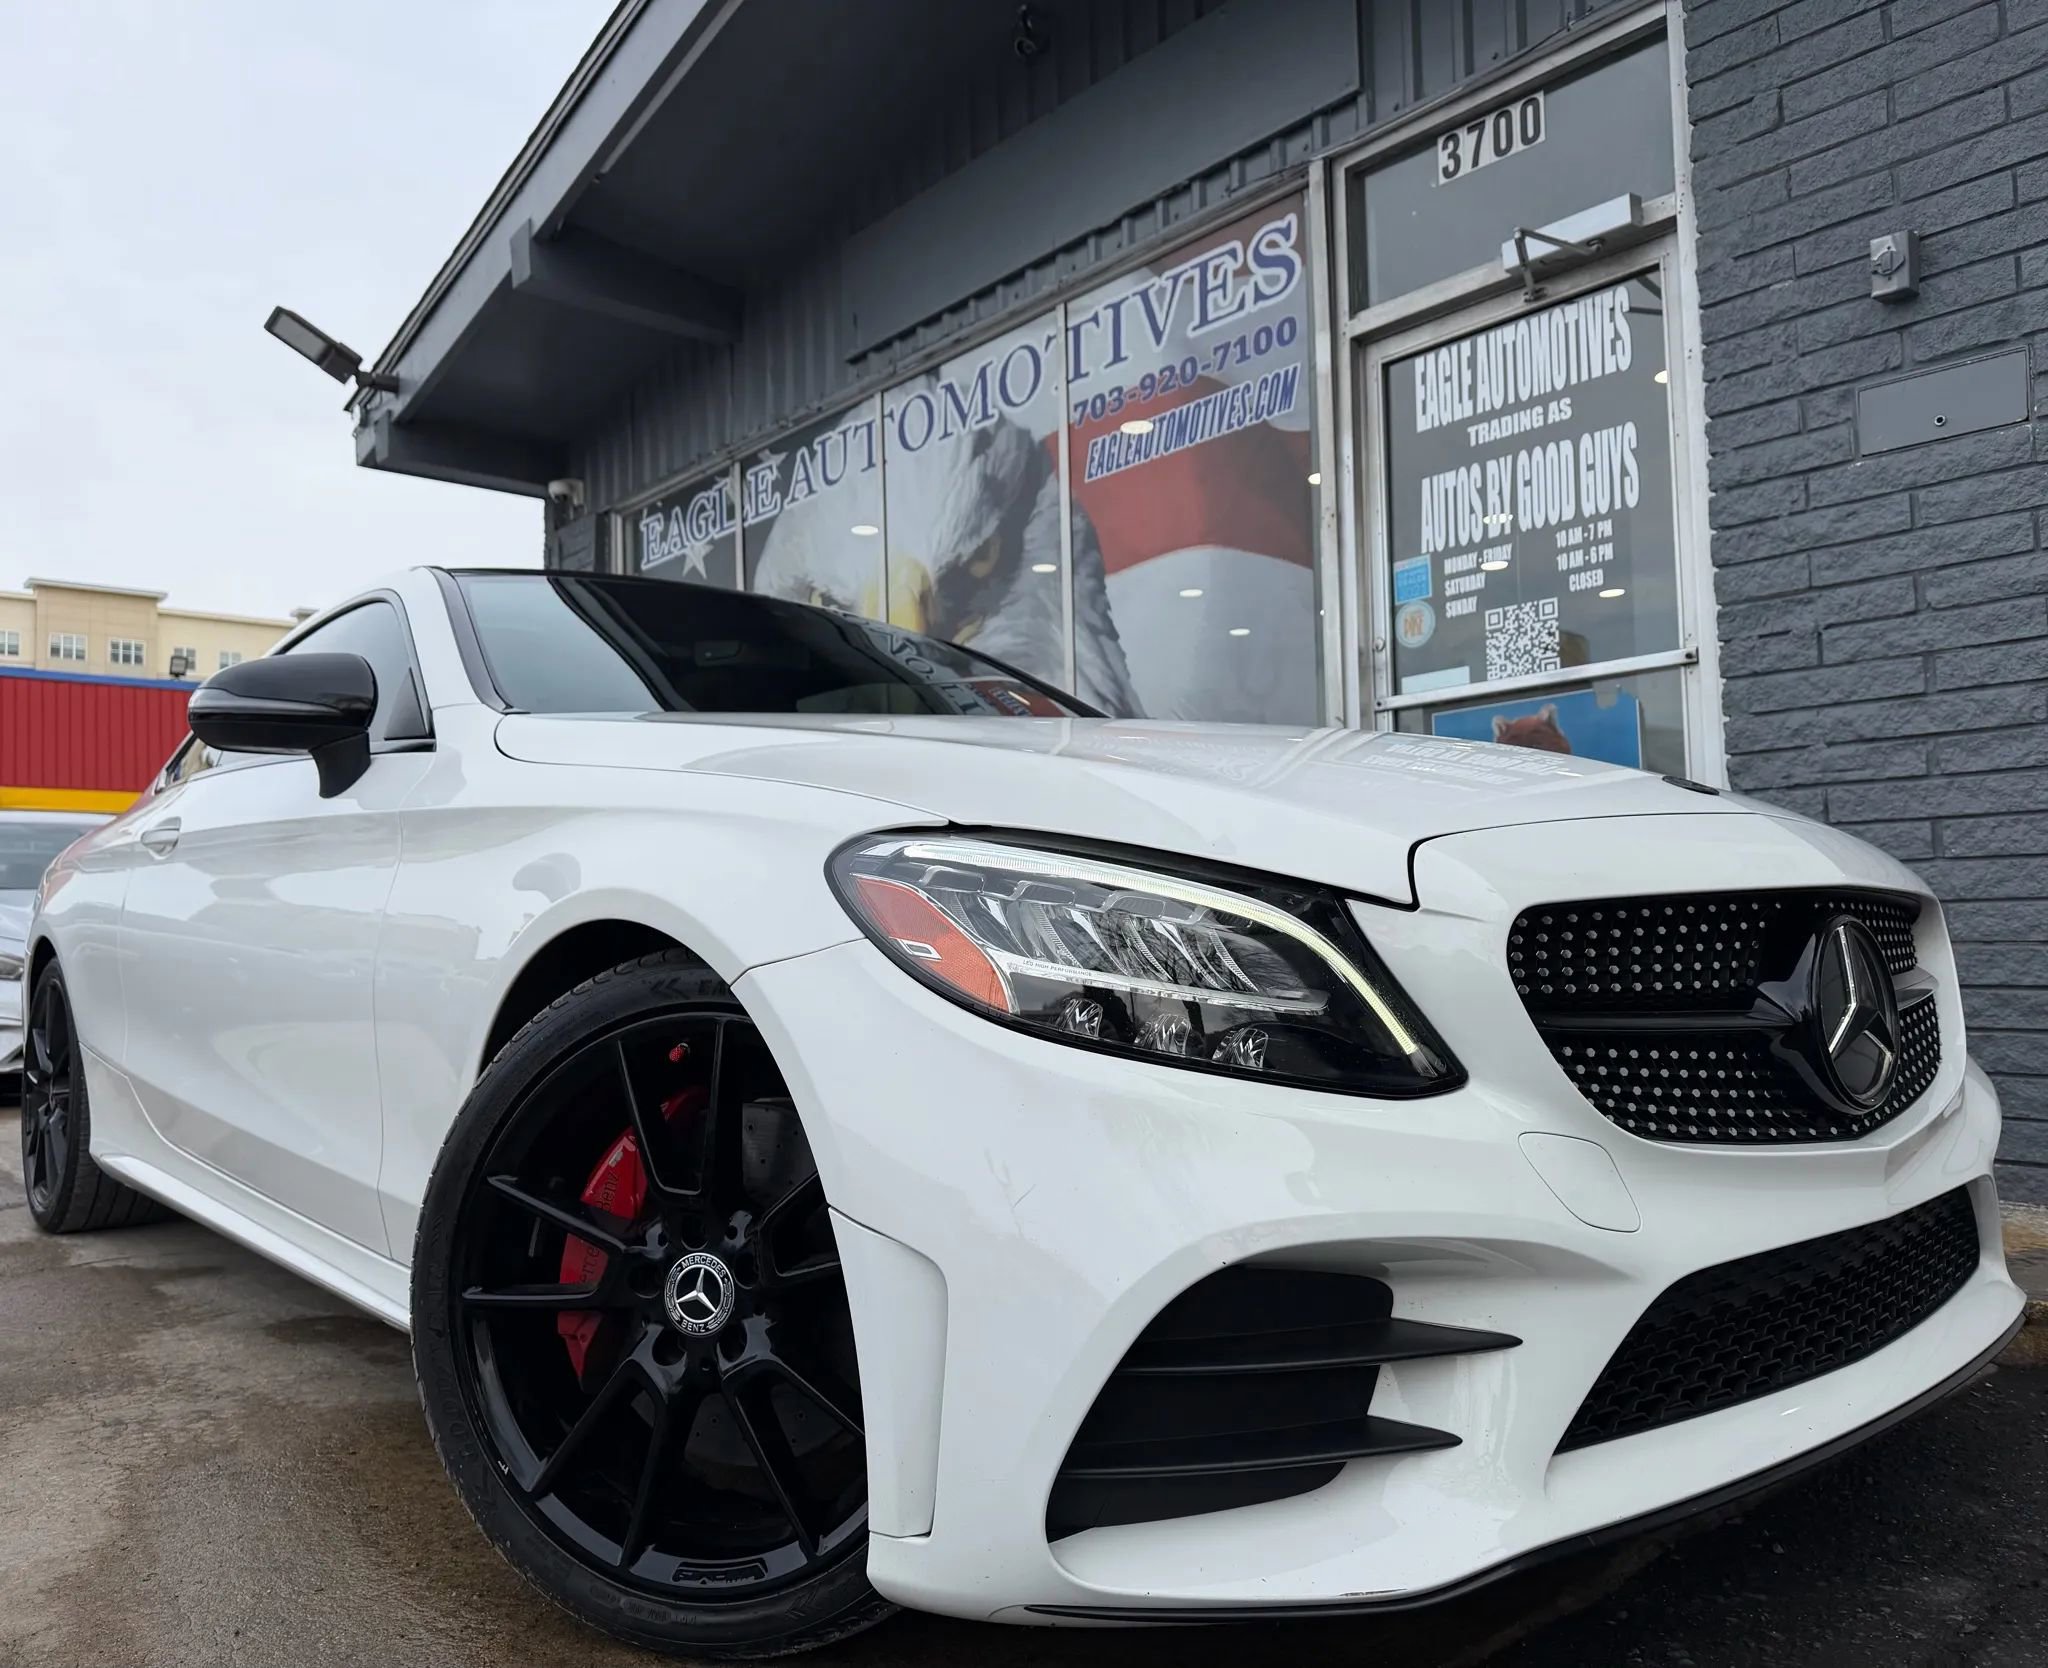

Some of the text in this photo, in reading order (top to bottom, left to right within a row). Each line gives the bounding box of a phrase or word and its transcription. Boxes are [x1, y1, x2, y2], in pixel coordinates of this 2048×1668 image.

[1441, 96, 1542, 181] 3700
[1073, 316, 1297, 427] 703-920-7100
[1414, 286, 1632, 434] EAGLE AUTOMOTIVES
[640, 214, 1301, 569] EAGLE AUTOMOTIVES
[1086, 364, 1299, 482] EAGLEAUTOMOTIVES.COM
[1467, 397, 1573, 447] TRADING AS
[1421, 421, 1640, 554] AUTOS BY GOOD GUYS
[1556, 530, 1567, 548] 10
[1567, 526, 1583, 547] AM
[1588, 523, 1595, 541] 7
[1597, 519, 1613, 539] PM
[1444, 551, 1478, 576] MONDAY
[1483, 543, 1513, 567] FRIDAY
[1556, 553, 1568, 572] 10
[1568, 549, 1584, 570] AM
[1590, 546, 1598, 565] 6
[1599, 542, 1614, 563] PM
[1444, 571, 1486, 597] SATURDAY
[1568, 568, 1604, 592] CLOSED
[1445, 596, 1478, 619] SUNDAY
[681, 1255, 727, 1278] MERCEDES
[681, 1319, 706, 1332] BENZ
